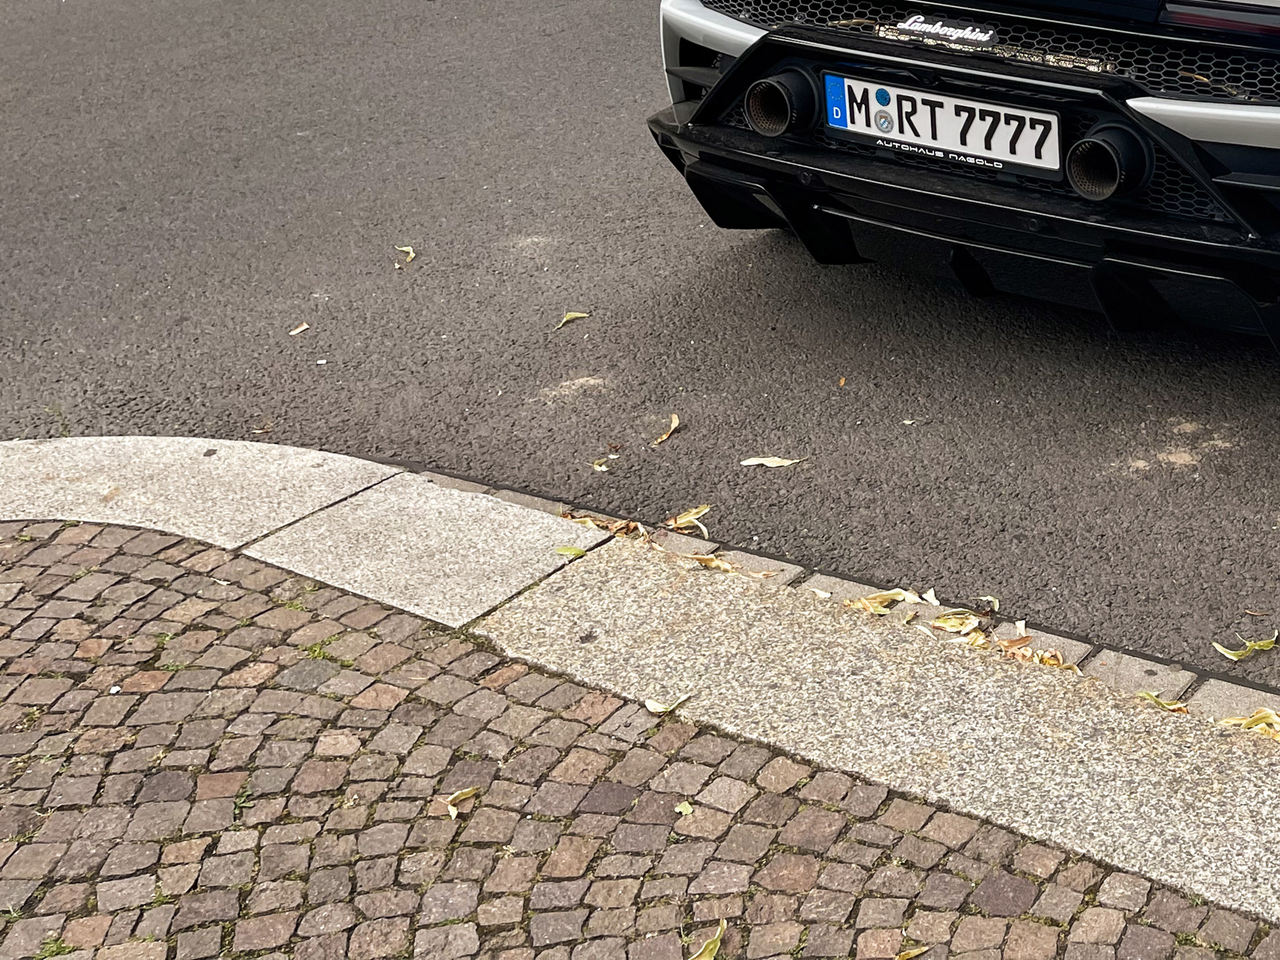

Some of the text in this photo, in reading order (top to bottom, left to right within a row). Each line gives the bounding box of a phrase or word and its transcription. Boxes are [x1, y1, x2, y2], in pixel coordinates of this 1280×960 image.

[897, 14, 994, 42] Lamborghini
[833, 106, 842, 119] D
[847, 84, 1052, 160] M RT 7777
[876, 139, 1003, 169] AUTOHAUS NAGOLD
